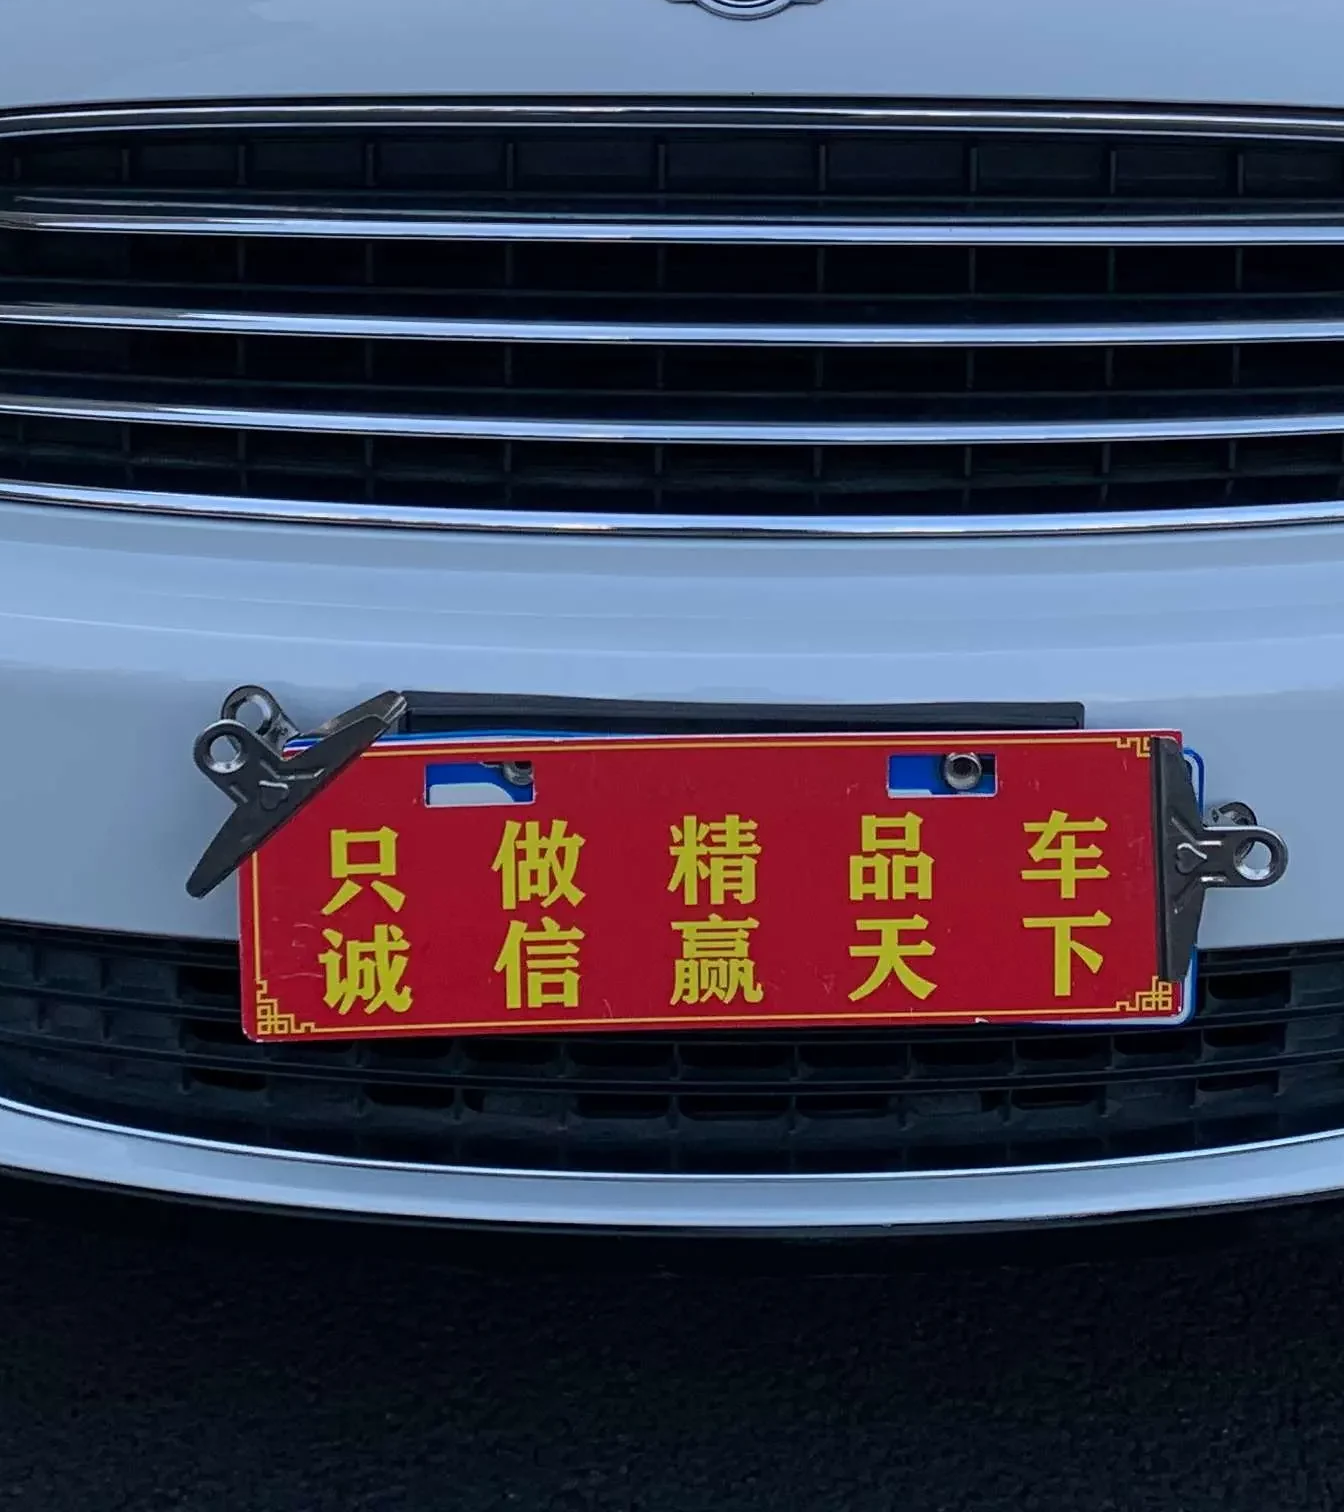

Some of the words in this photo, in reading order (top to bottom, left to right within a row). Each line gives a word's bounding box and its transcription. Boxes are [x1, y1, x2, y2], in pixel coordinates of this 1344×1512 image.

[321, 809, 1111, 916] 只做精品车
[317, 911, 1113, 1016] 诚信赢天下
